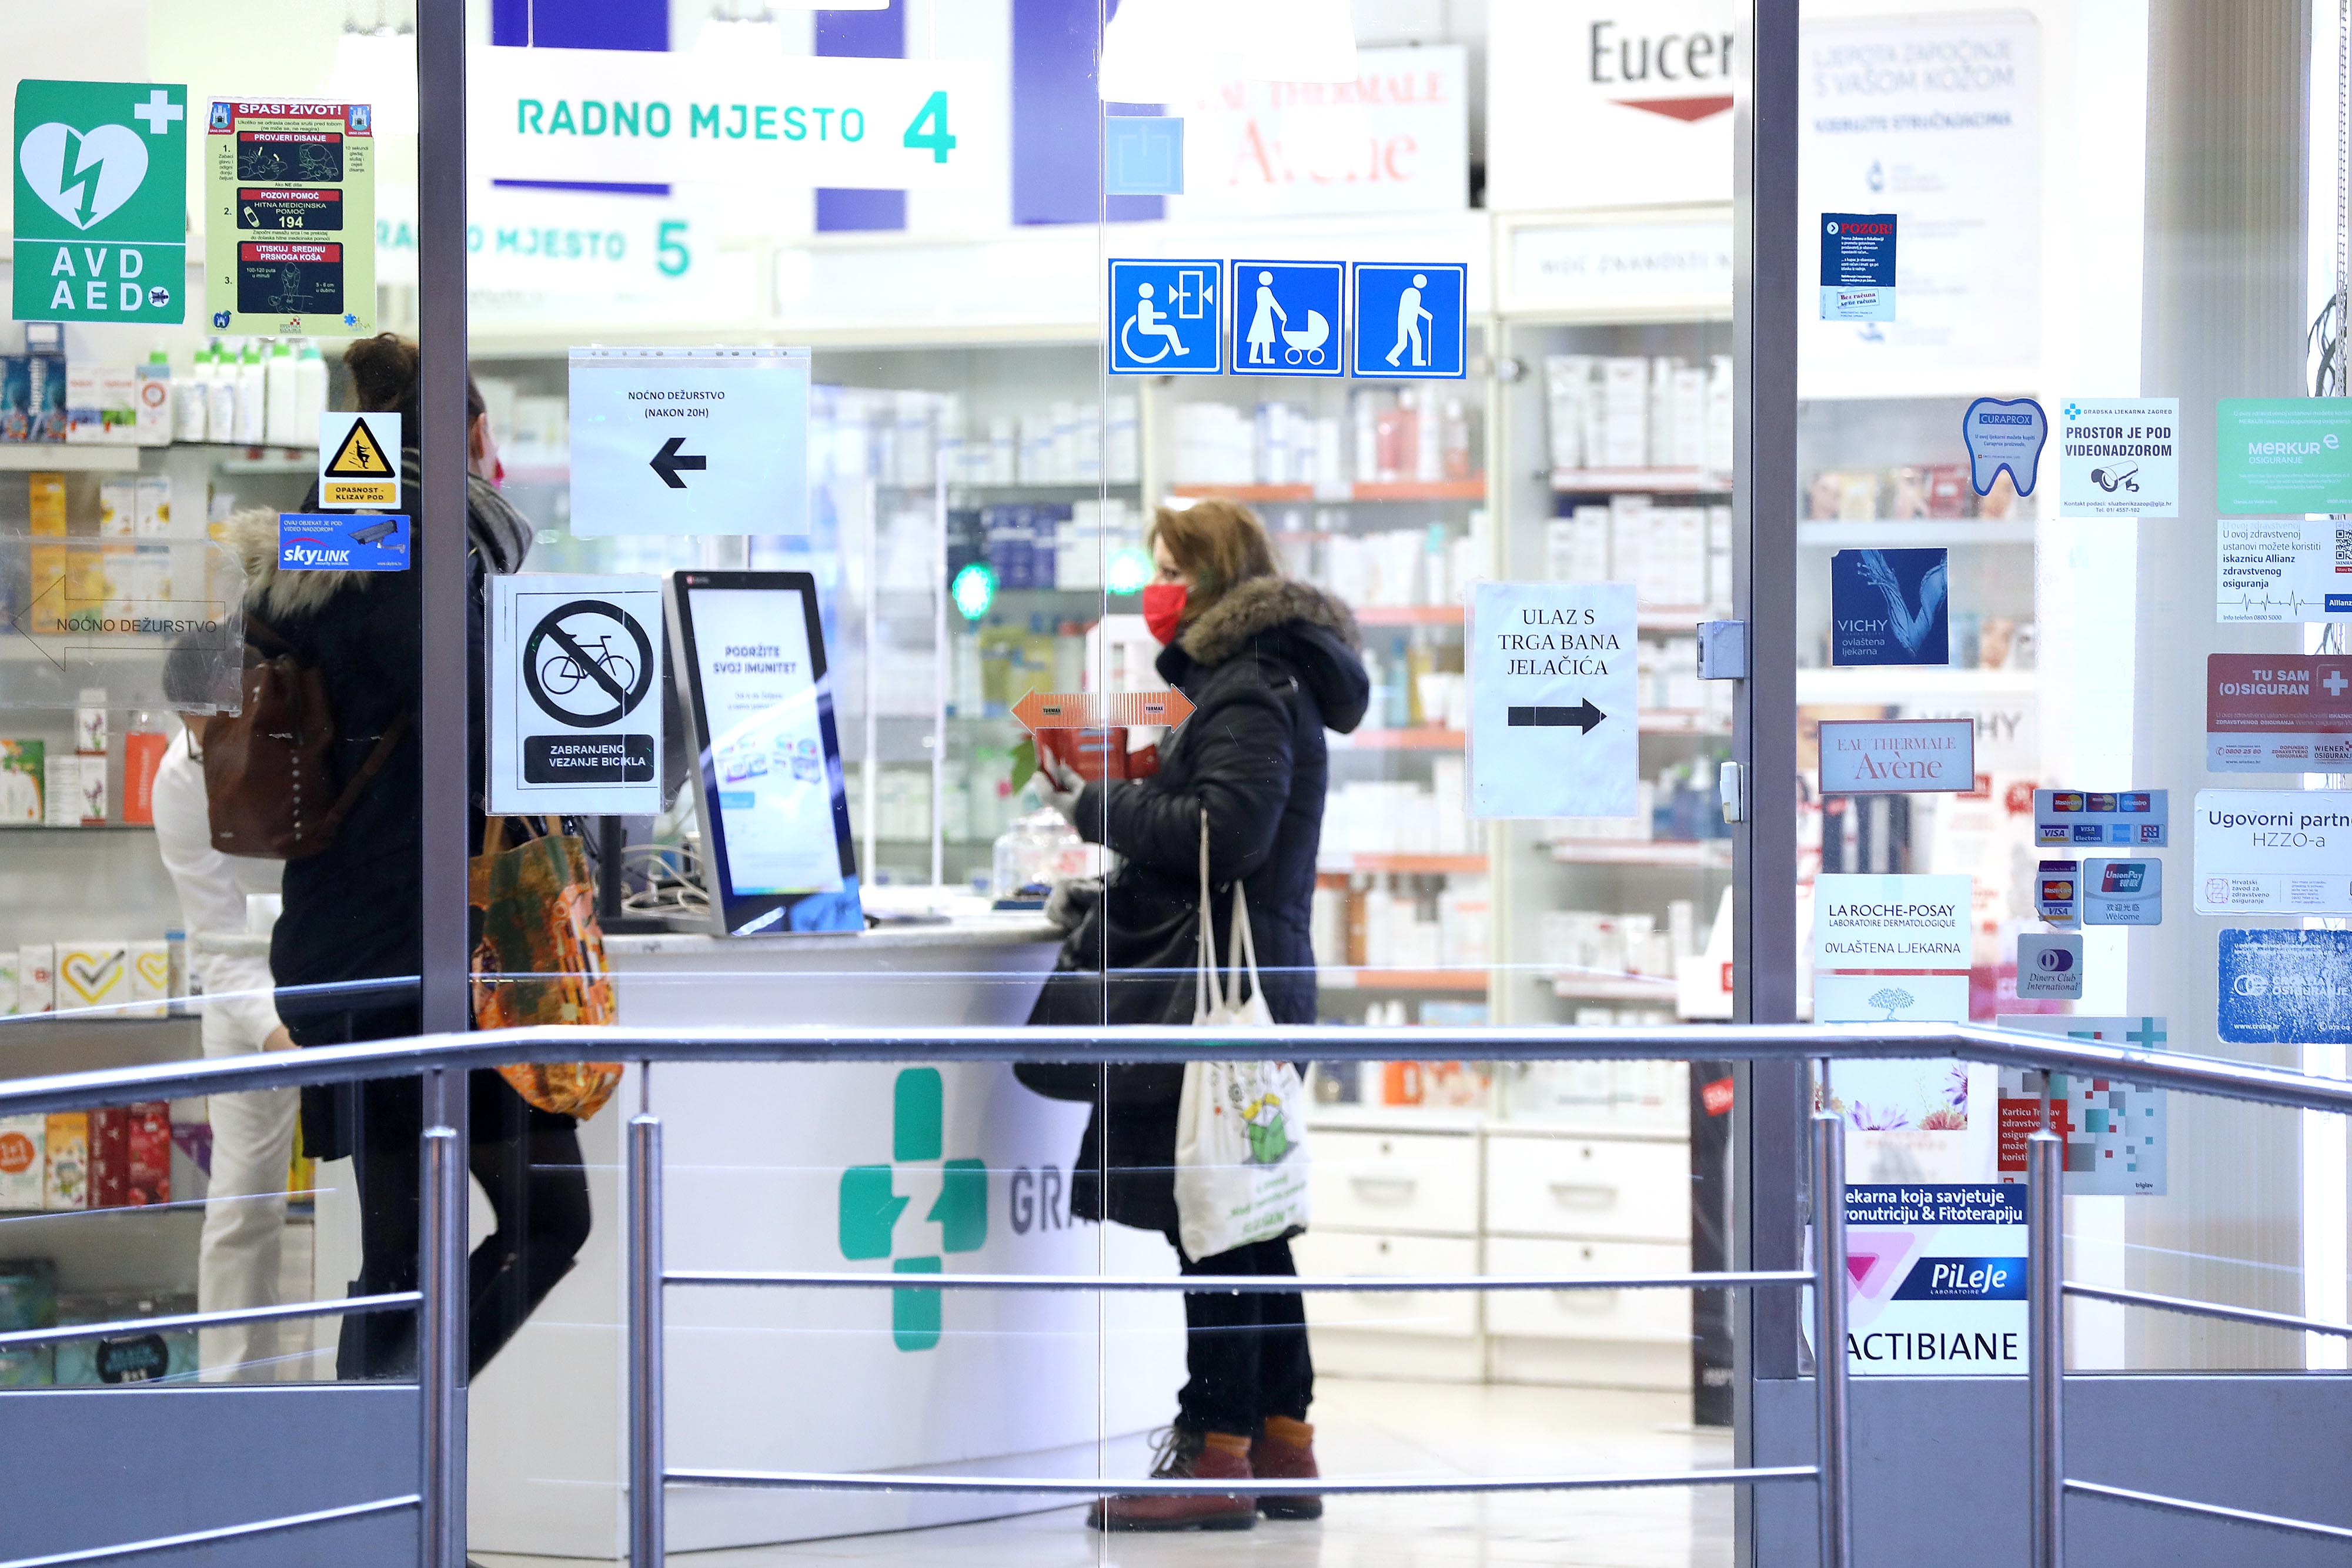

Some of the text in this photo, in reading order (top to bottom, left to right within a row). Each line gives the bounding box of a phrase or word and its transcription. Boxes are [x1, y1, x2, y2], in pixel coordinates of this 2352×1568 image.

[238, 103, 341, 115] SPASI ŽIVOT!
[517, 89, 956, 164] RADNO MJESTO 4
[279, 216, 303, 228] 194
[1840, 223, 1893, 235] POZOR!
[496, 220, 692, 277] MJESTO 5
[51, 247, 142, 278] AVD
[300, 253, 322, 261] KOŠA
[51, 280, 142, 310] AED
[628, 389, 726, 400] NOĆNO DEŽURSTVO
[644, 408, 709, 420] (NAKON 20H)
[1981, 413, 2031, 424] CURAPROX
[2066, 427, 2171, 439] PROSTOR JE POD
[2065, 444, 2172, 456] VIDEONADZOROM
[2231, 530, 2248, 540] ovoj
[2250, 530, 2301, 540] zdravstvenoj
[2259, 542, 2289, 550] možete
[2292, 541, 2321, 550] koristiti
[2223, 554, 2295, 563] iskaznicu Allianz
[2223, 567, 2282, 577] zdravstvenog
[2223, 580, 2269, 589] osiguranja
[1522, 609, 1595, 625] ULAZ S
[57, 614, 218, 634] NOĆNO DEŽURSTVO
[1838, 620, 1887, 631] VICHY
[1498, 634, 1621, 650] TRGA BANA
[1842, 647, 1877, 656] ljekarna
[745, 661, 797, 674] IMUNITET
[1507, 655, 1609, 676] JELAČIĆA
[2253, 670, 2309, 681] TU SAM
[2219, 683, 2309, 696] (O)SIGURAN
[550, 744, 625, 754] ZABRANJENO
[1838, 737, 1956, 751] EAU THERMALE
[549, 757, 646, 767] VEZANJE BICIKLA
[1855, 751, 1942, 779] Avène
[2209, 811, 2352, 830] Ugovorni partn
[2253, 832, 2326, 847] HZZO-a
[2106, 870, 2143, 881] UnionPay
[1830, 905, 1956, 917] LA ROCHE-POSAY
[1883, 920, 1956, 928] DERMATOLOGIQUE
[1825, 940, 1961, 953] OVLAŠTENA LJEKARNA
[2029, 973, 2076, 982] Diners Club
[2027, 982, 2079, 991] International
[2002, 1108, 2031, 1116] Karticu
[1901, 1189, 1933, 1206] koja
[1937, 1189, 2005, 1206] savjetuje
[1922, 1206, 1936, 1221] &
[1939, 1207, 2023, 1225] Fitoterapiju
[1932, 1263, 2007, 1293] PiLeJe
